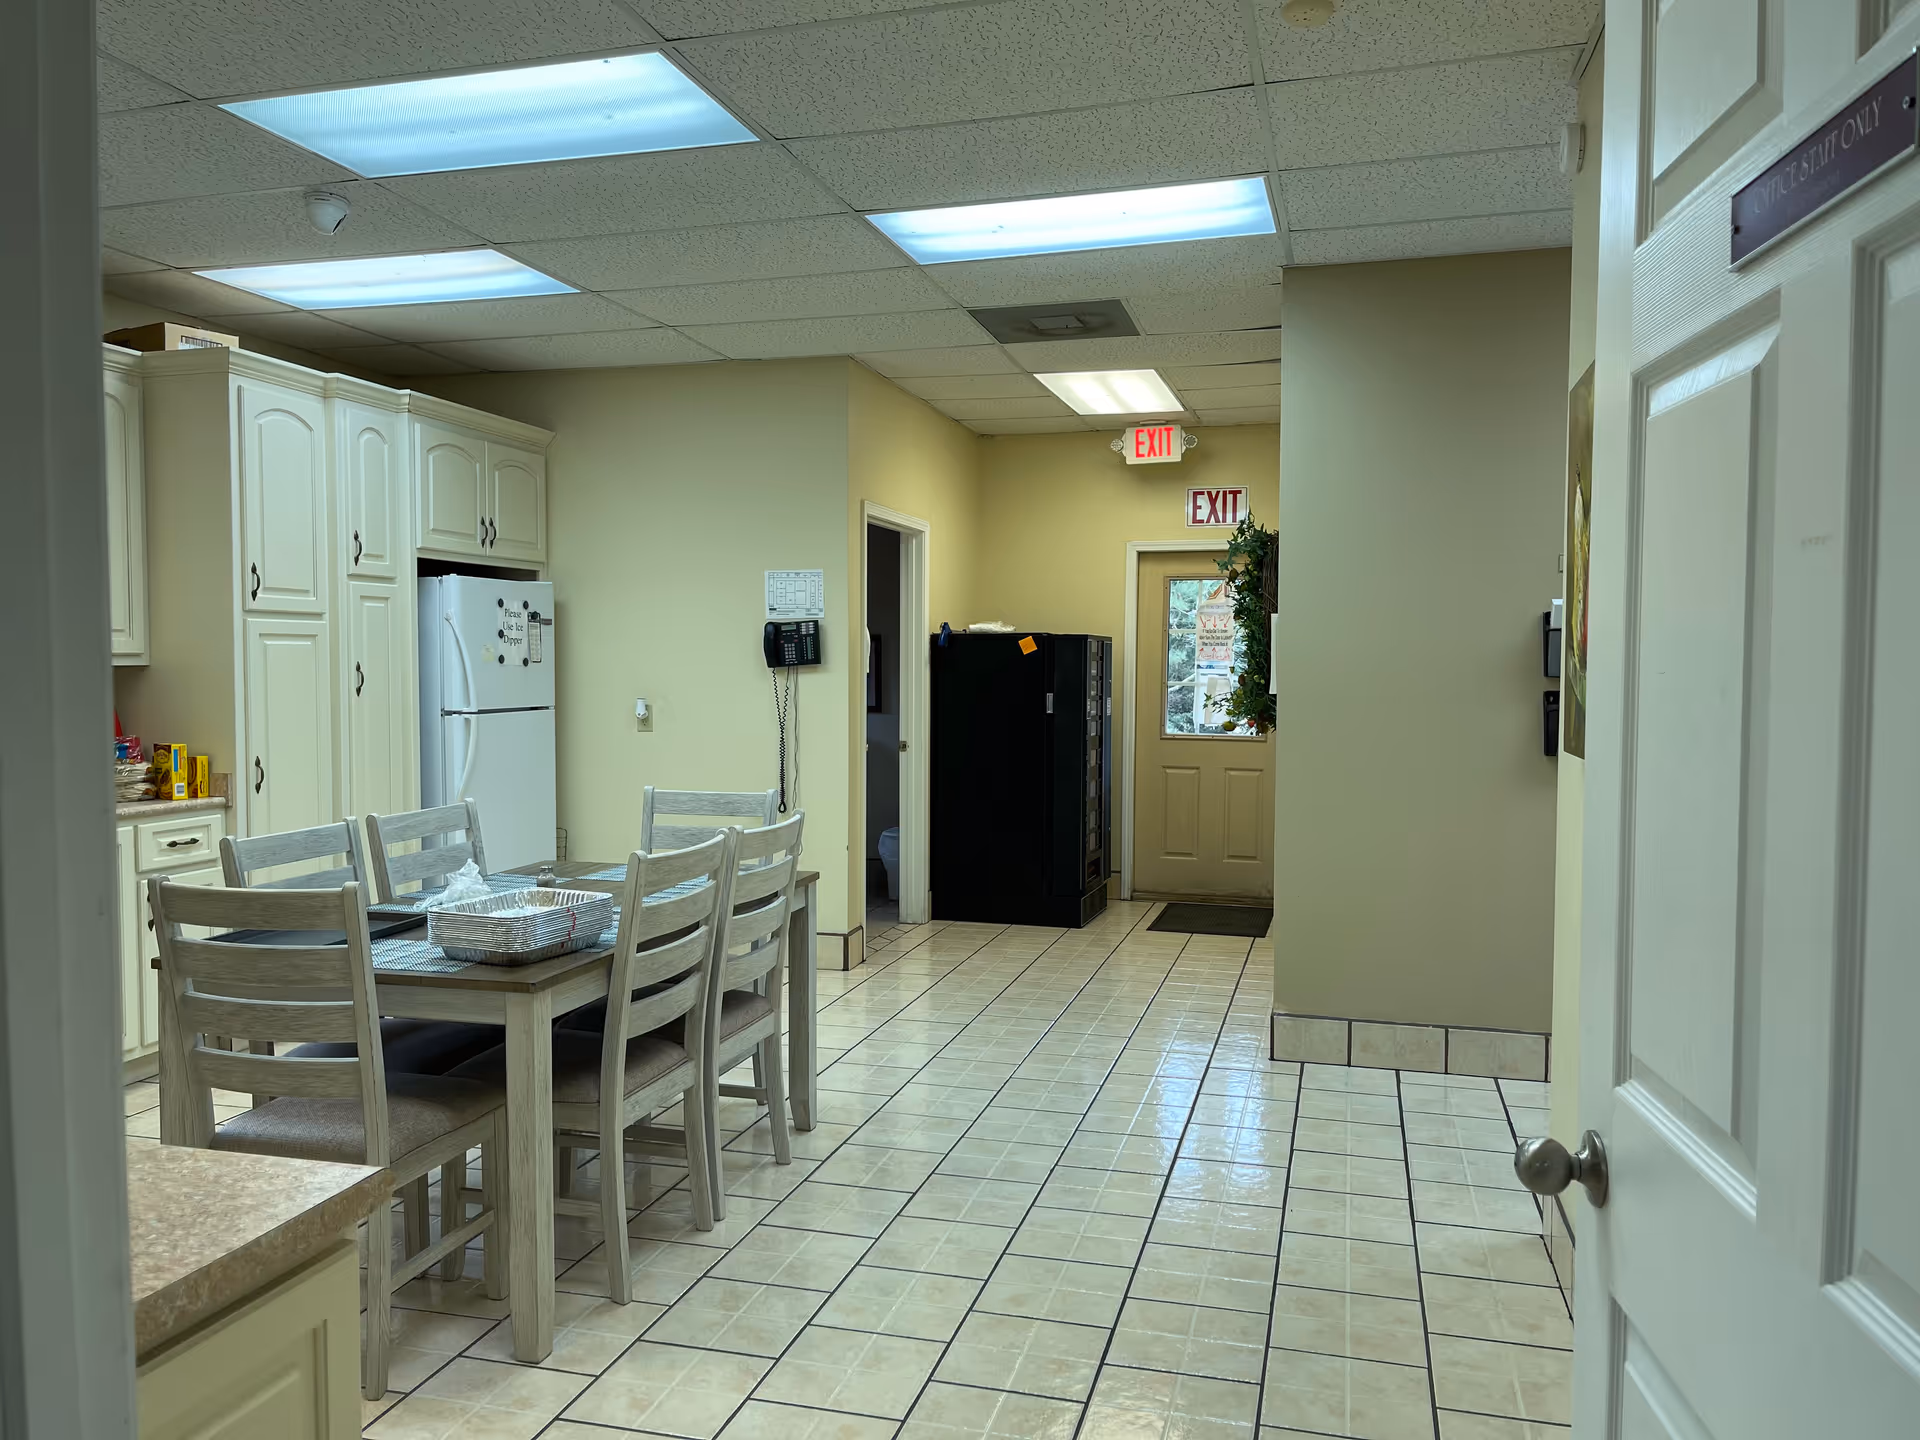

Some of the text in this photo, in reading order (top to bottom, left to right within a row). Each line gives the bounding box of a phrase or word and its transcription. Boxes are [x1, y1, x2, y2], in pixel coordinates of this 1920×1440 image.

[1799, 130, 1839, 181] STAFF
[1841, 96, 1883, 150] ONLY
[1135, 426, 1174, 458] EXIT
[1191, 489, 1243, 524] EXIT
[504, 608, 522, 618] Please
[503, 621, 523, 631] Use Ice
[503, 635, 523, 646] Dipper
